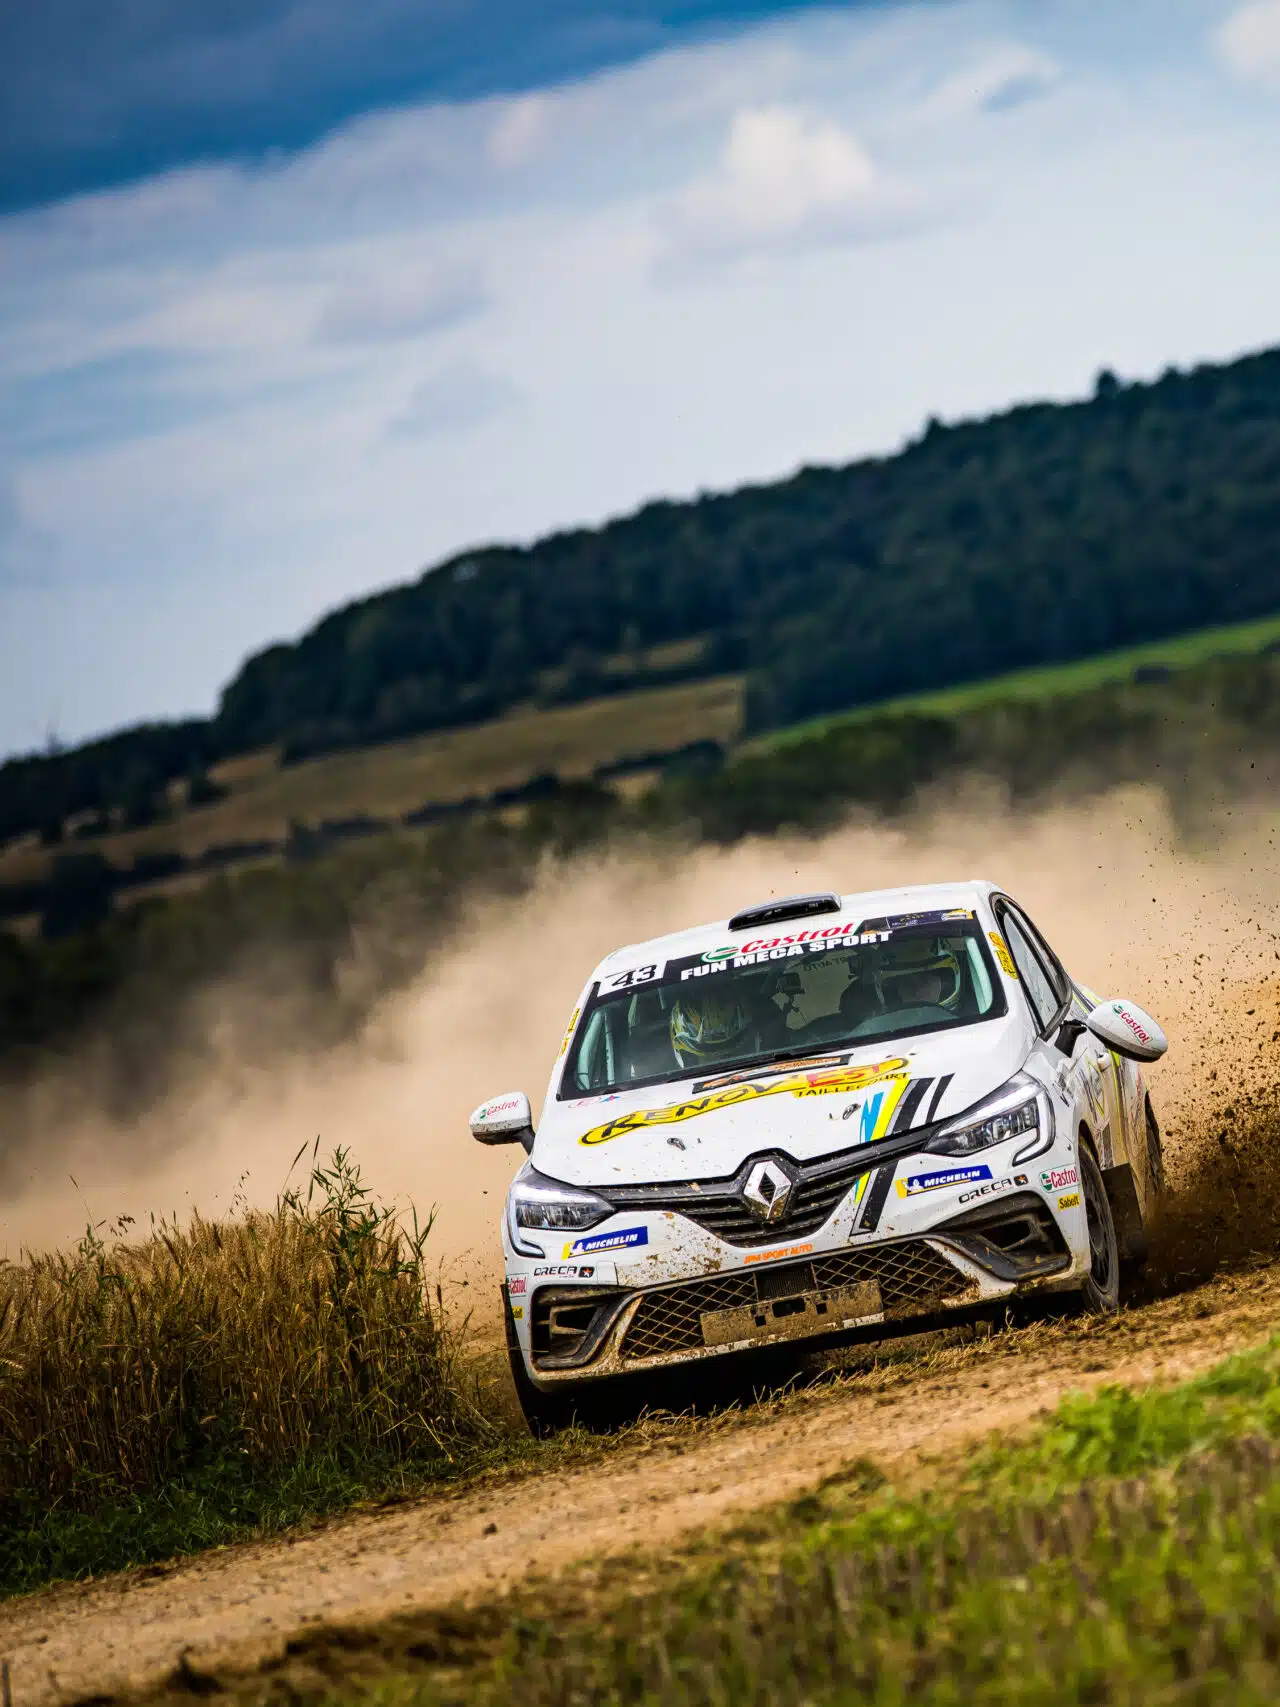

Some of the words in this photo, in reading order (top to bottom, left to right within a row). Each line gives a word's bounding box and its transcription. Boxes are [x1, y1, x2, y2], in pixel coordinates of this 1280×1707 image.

[740, 922, 854, 953] Castrol
[680, 961, 727, 981] FUN
[734, 945, 804, 969] MECA
[810, 931, 893, 952] SPORT
[611, 964, 657, 987] 43
[1120, 1011, 1150, 1043] Castrol
[486, 1099, 519, 1116] Castrol
[924, 1170, 981, 1187] MICHELIN
[1050, 1165, 1079, 1189] Castrol
[958, 1178, 1013, 1205] ORECA
[1059, 1195, 1080, 1209] Sabelt
[585, 1233, 638, 1251] MICHELIN
[791, 1243, 813, 1255] AUTO
[533, 1266, 578, 1277] ORECA
